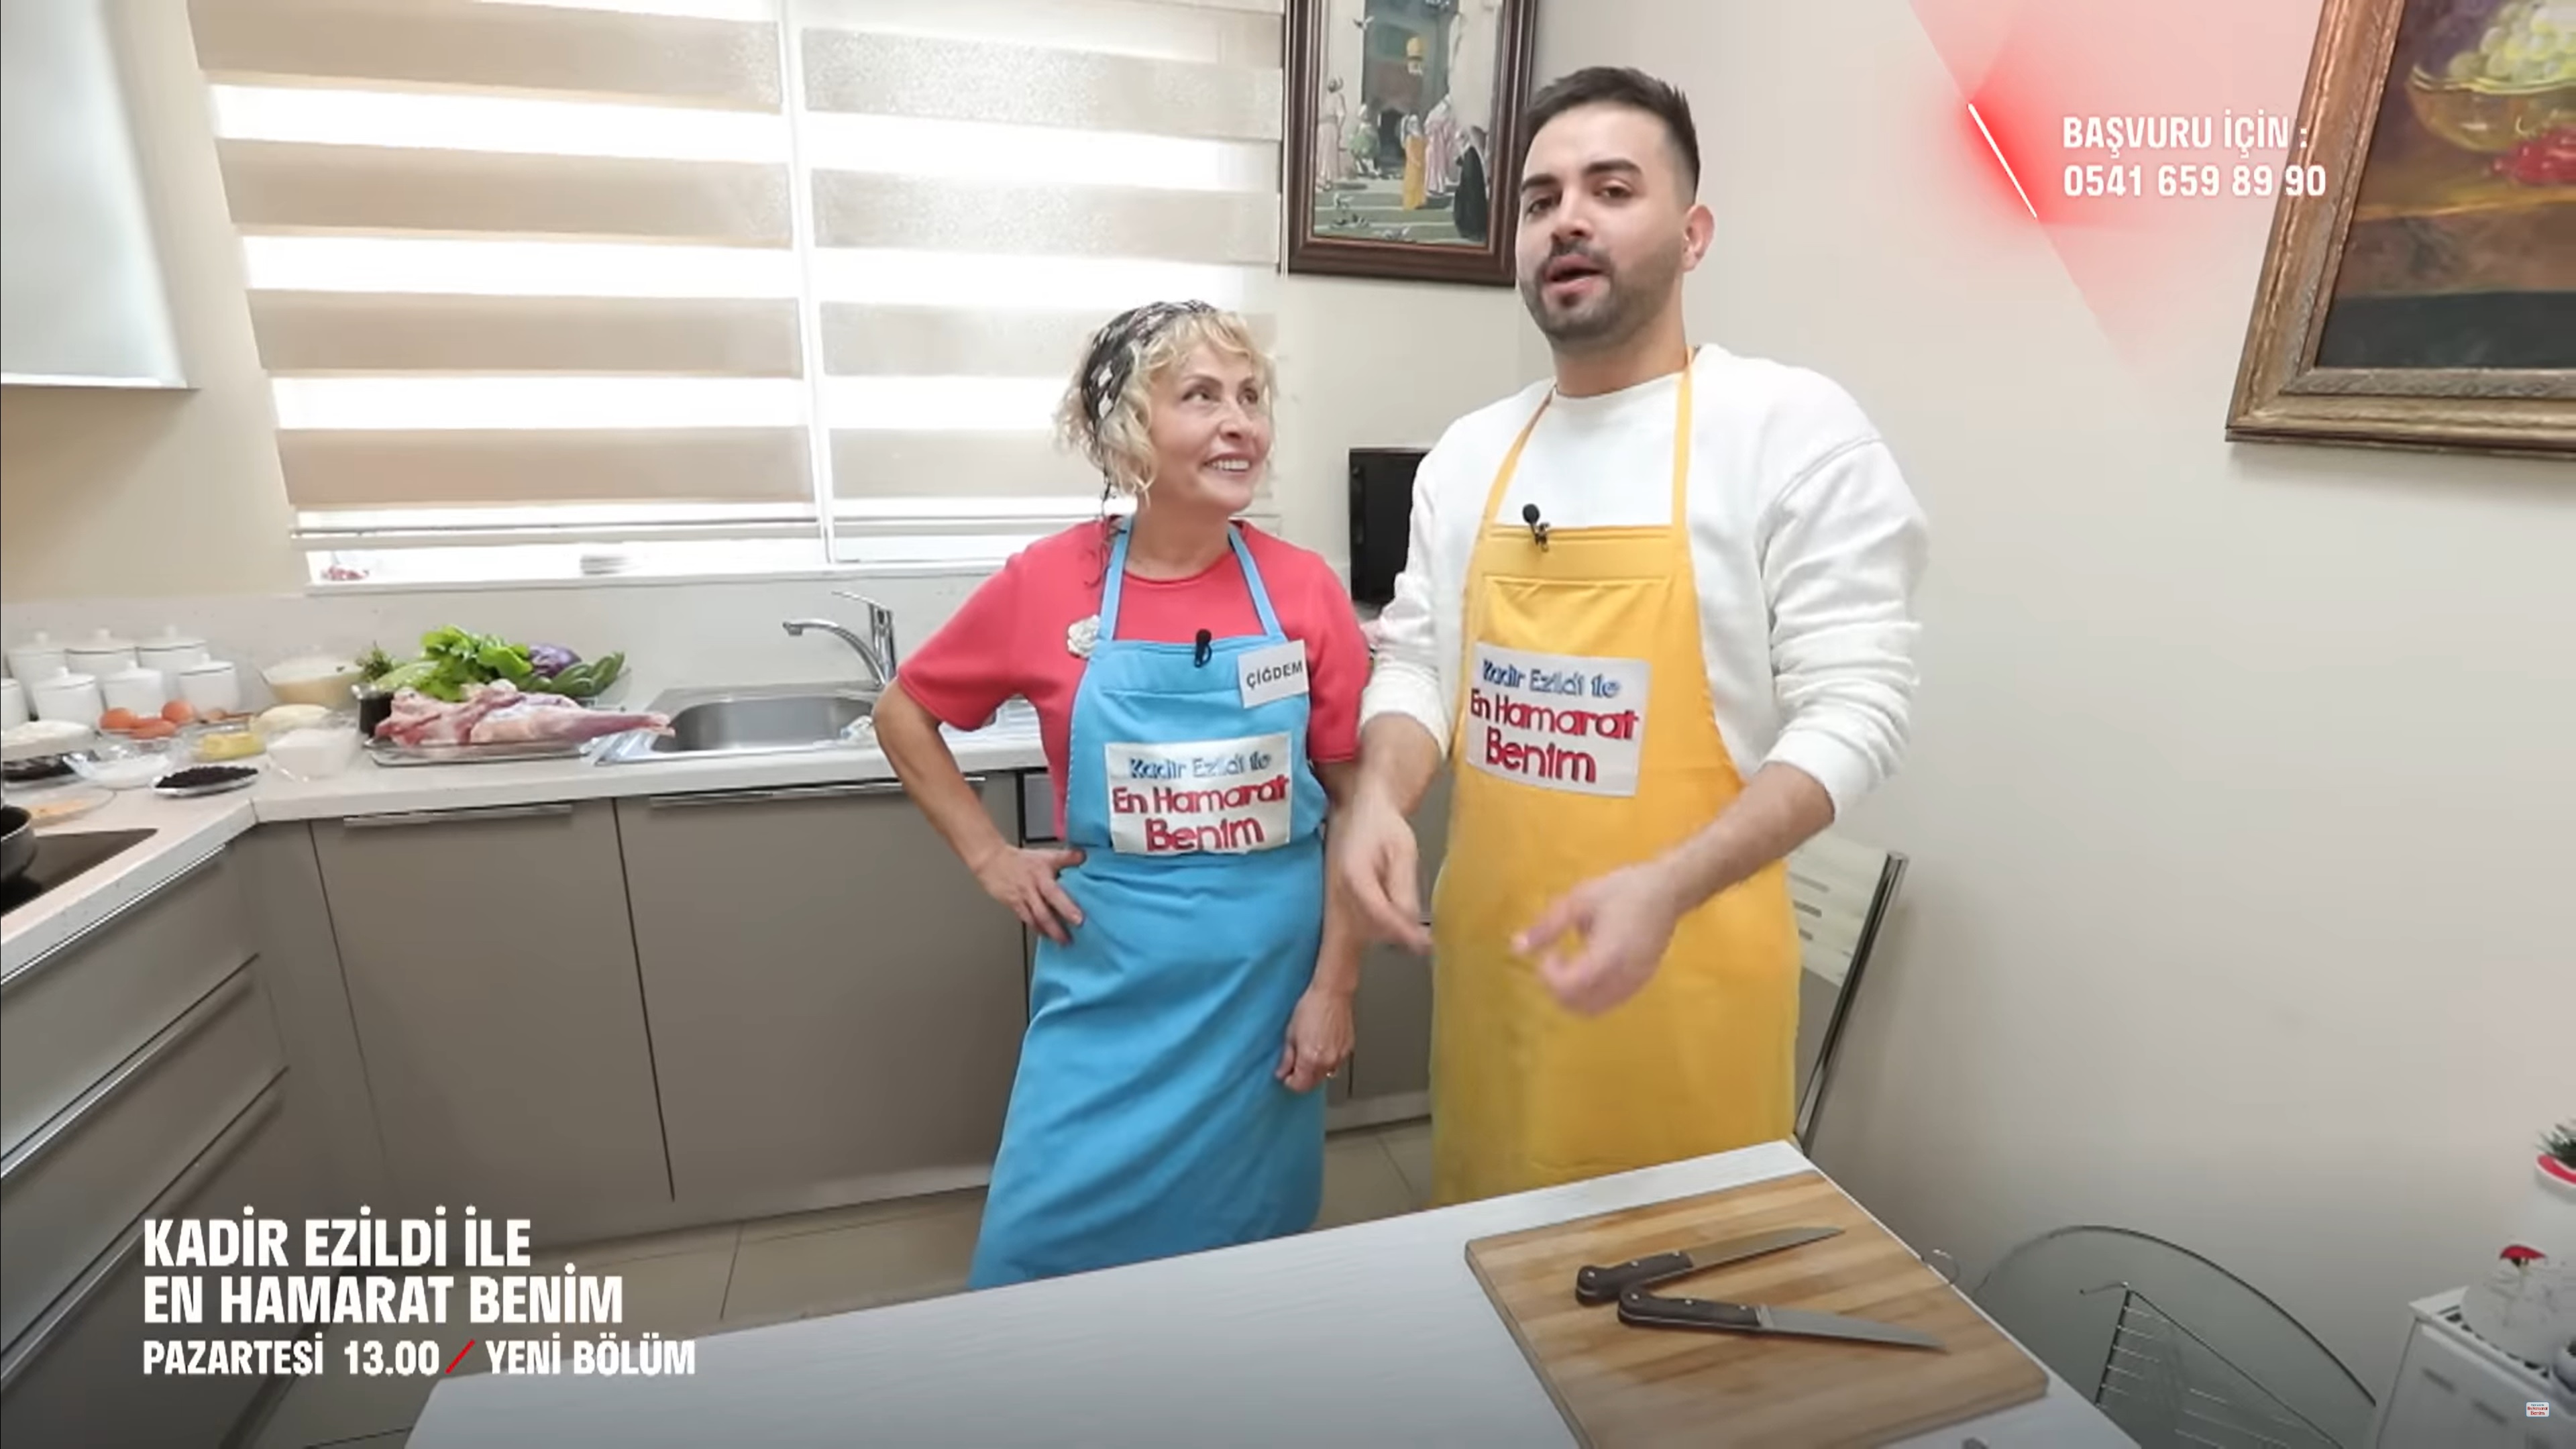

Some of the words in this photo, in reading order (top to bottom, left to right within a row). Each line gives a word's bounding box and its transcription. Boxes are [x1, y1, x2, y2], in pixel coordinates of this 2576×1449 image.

[1470, 688, 1491, 720] En
[1495, 693, 1640, 740] Hamarat
[1485, 725, 1597, 784] Benim
[1112, 786, 1148, 814] En
[1152, 773, 1289, 814] Hamarat
[1145, 816, 1265, 851] Benim
